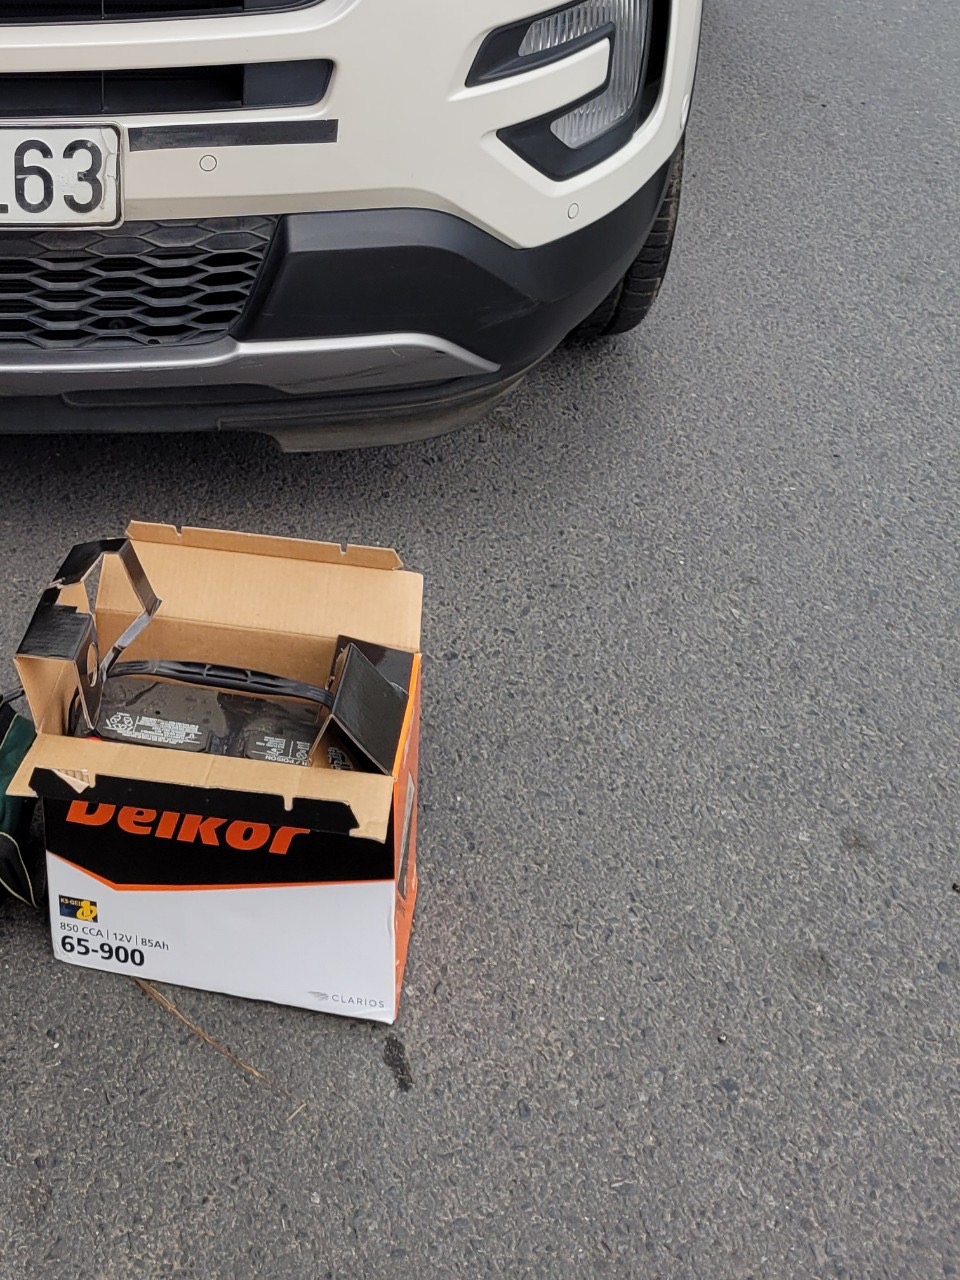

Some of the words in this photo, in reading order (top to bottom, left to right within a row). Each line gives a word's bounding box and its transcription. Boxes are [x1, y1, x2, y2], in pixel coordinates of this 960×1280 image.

[60, 921, 79, 933] 850
[82, 926, 104, 938] CCA
[113, 932, 133, 943] 12V
[141, 937, 169, 950] 85Ah
[60, 934, 145, 967] 65-900
[331, 993, 385, 1009] CLARIOS
